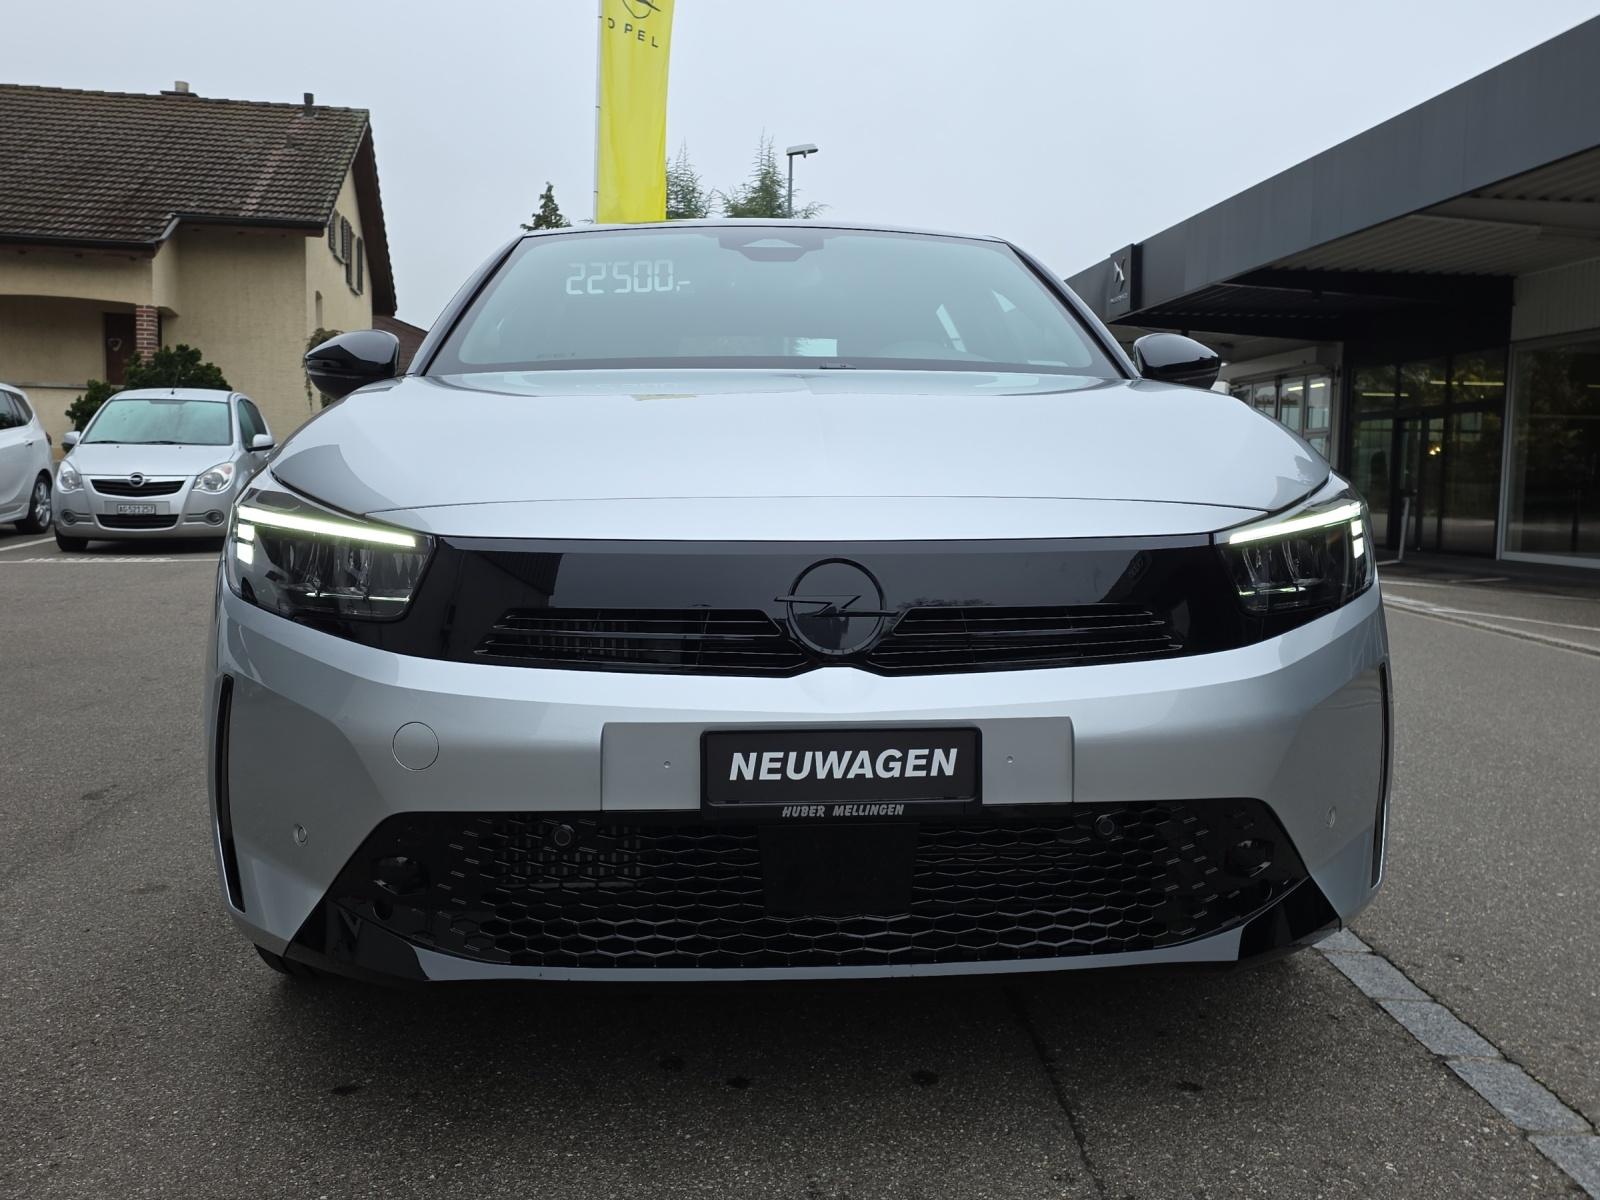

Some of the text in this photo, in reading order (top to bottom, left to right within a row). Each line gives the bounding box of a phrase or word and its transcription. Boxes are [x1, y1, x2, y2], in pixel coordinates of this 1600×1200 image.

[729, 748, 958, 781] NEUWAGEN
[782, 804, 905, 818] HUBER MELLINGEN
